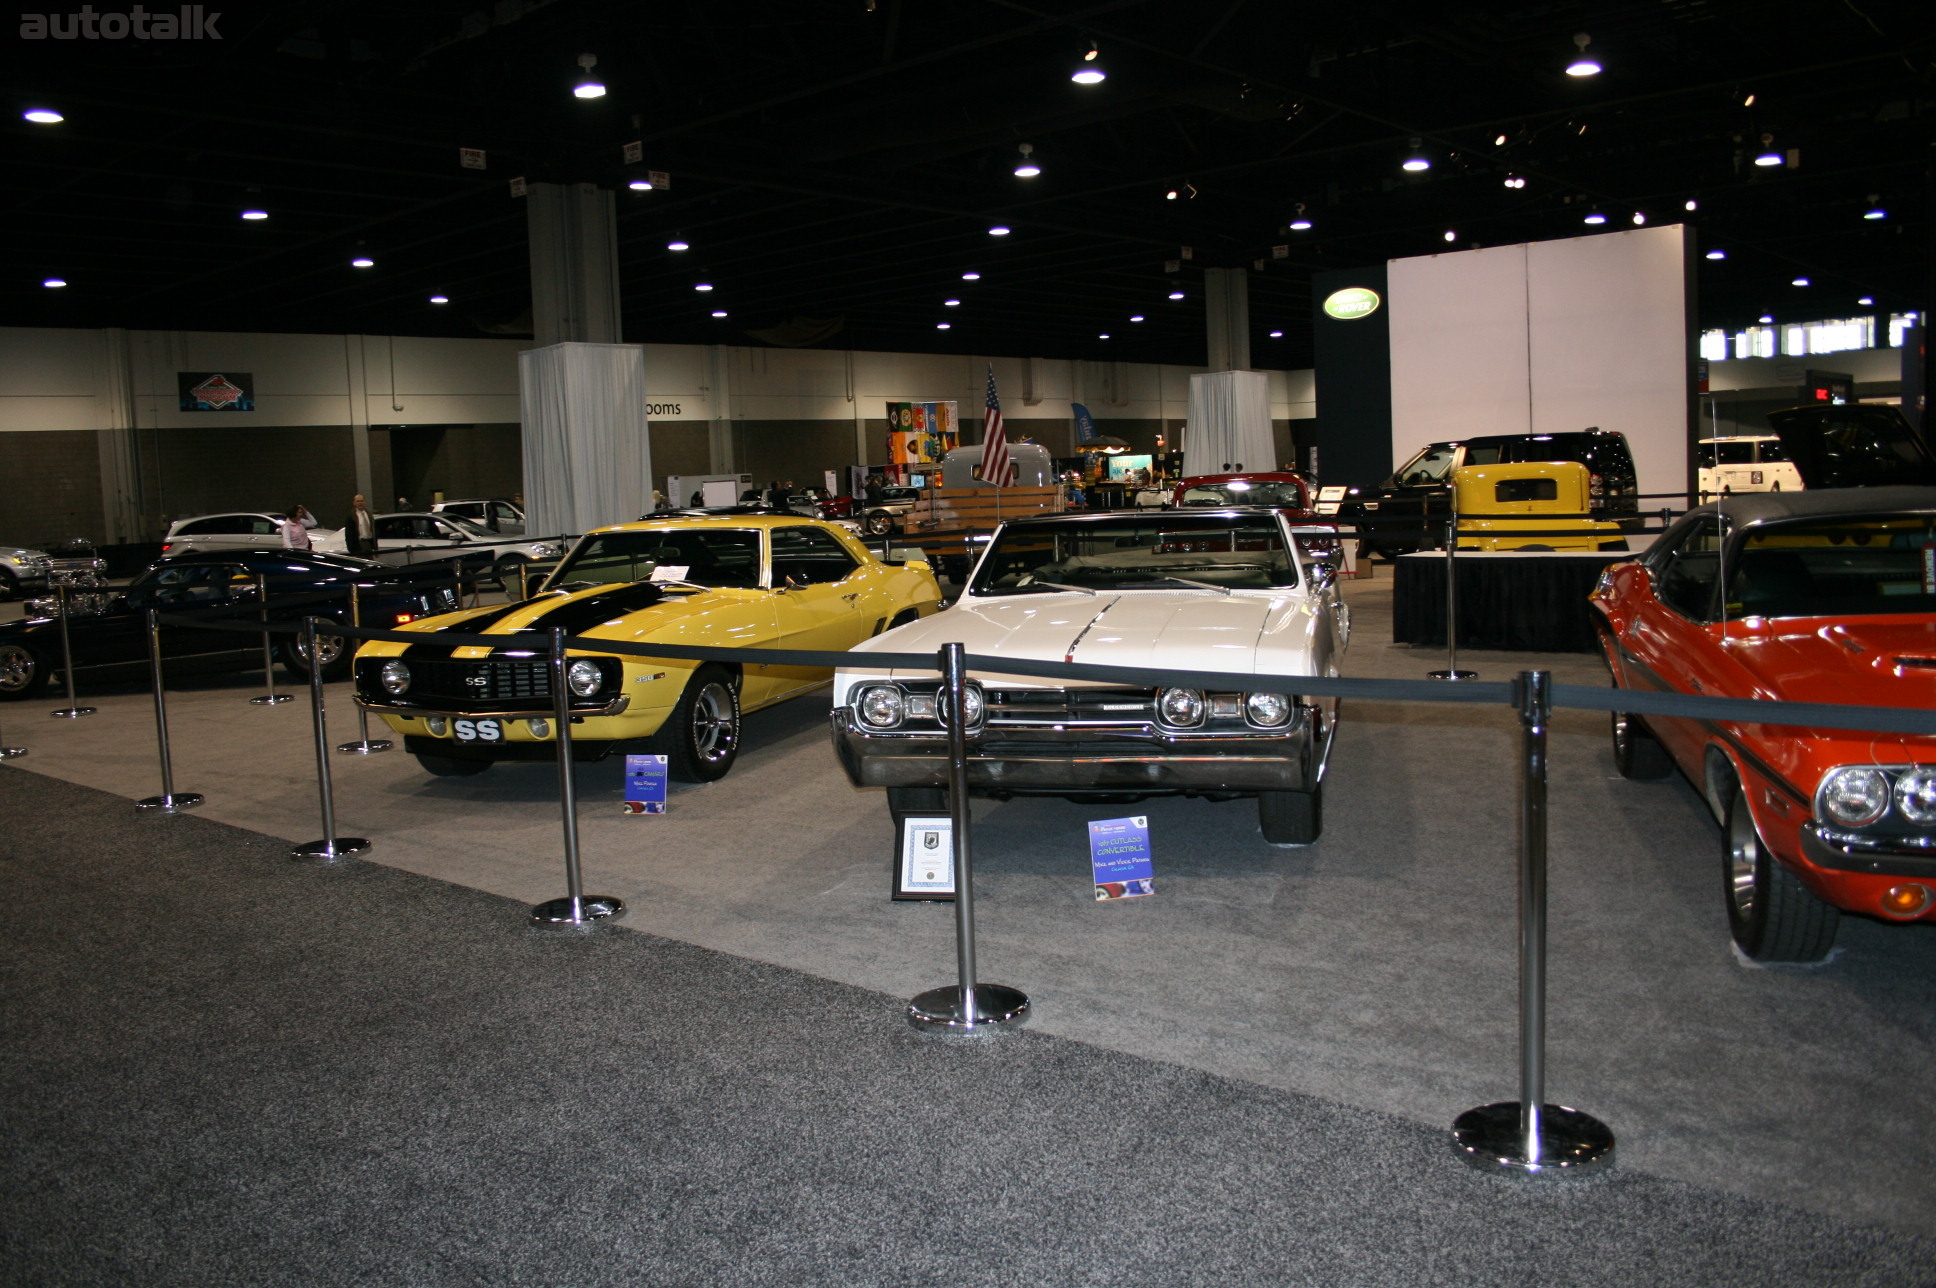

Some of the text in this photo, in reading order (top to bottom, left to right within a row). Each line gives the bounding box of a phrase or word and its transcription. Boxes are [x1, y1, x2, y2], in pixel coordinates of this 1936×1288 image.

[1111, 459, 1133, 468] Your
[465, 677, 487, 685] SS
[455, 720, 500, 740] SS
[1110, 836, 1142, 845] CUTLASS
[1097, 844, 1145, 856] CONVERTIBLE
